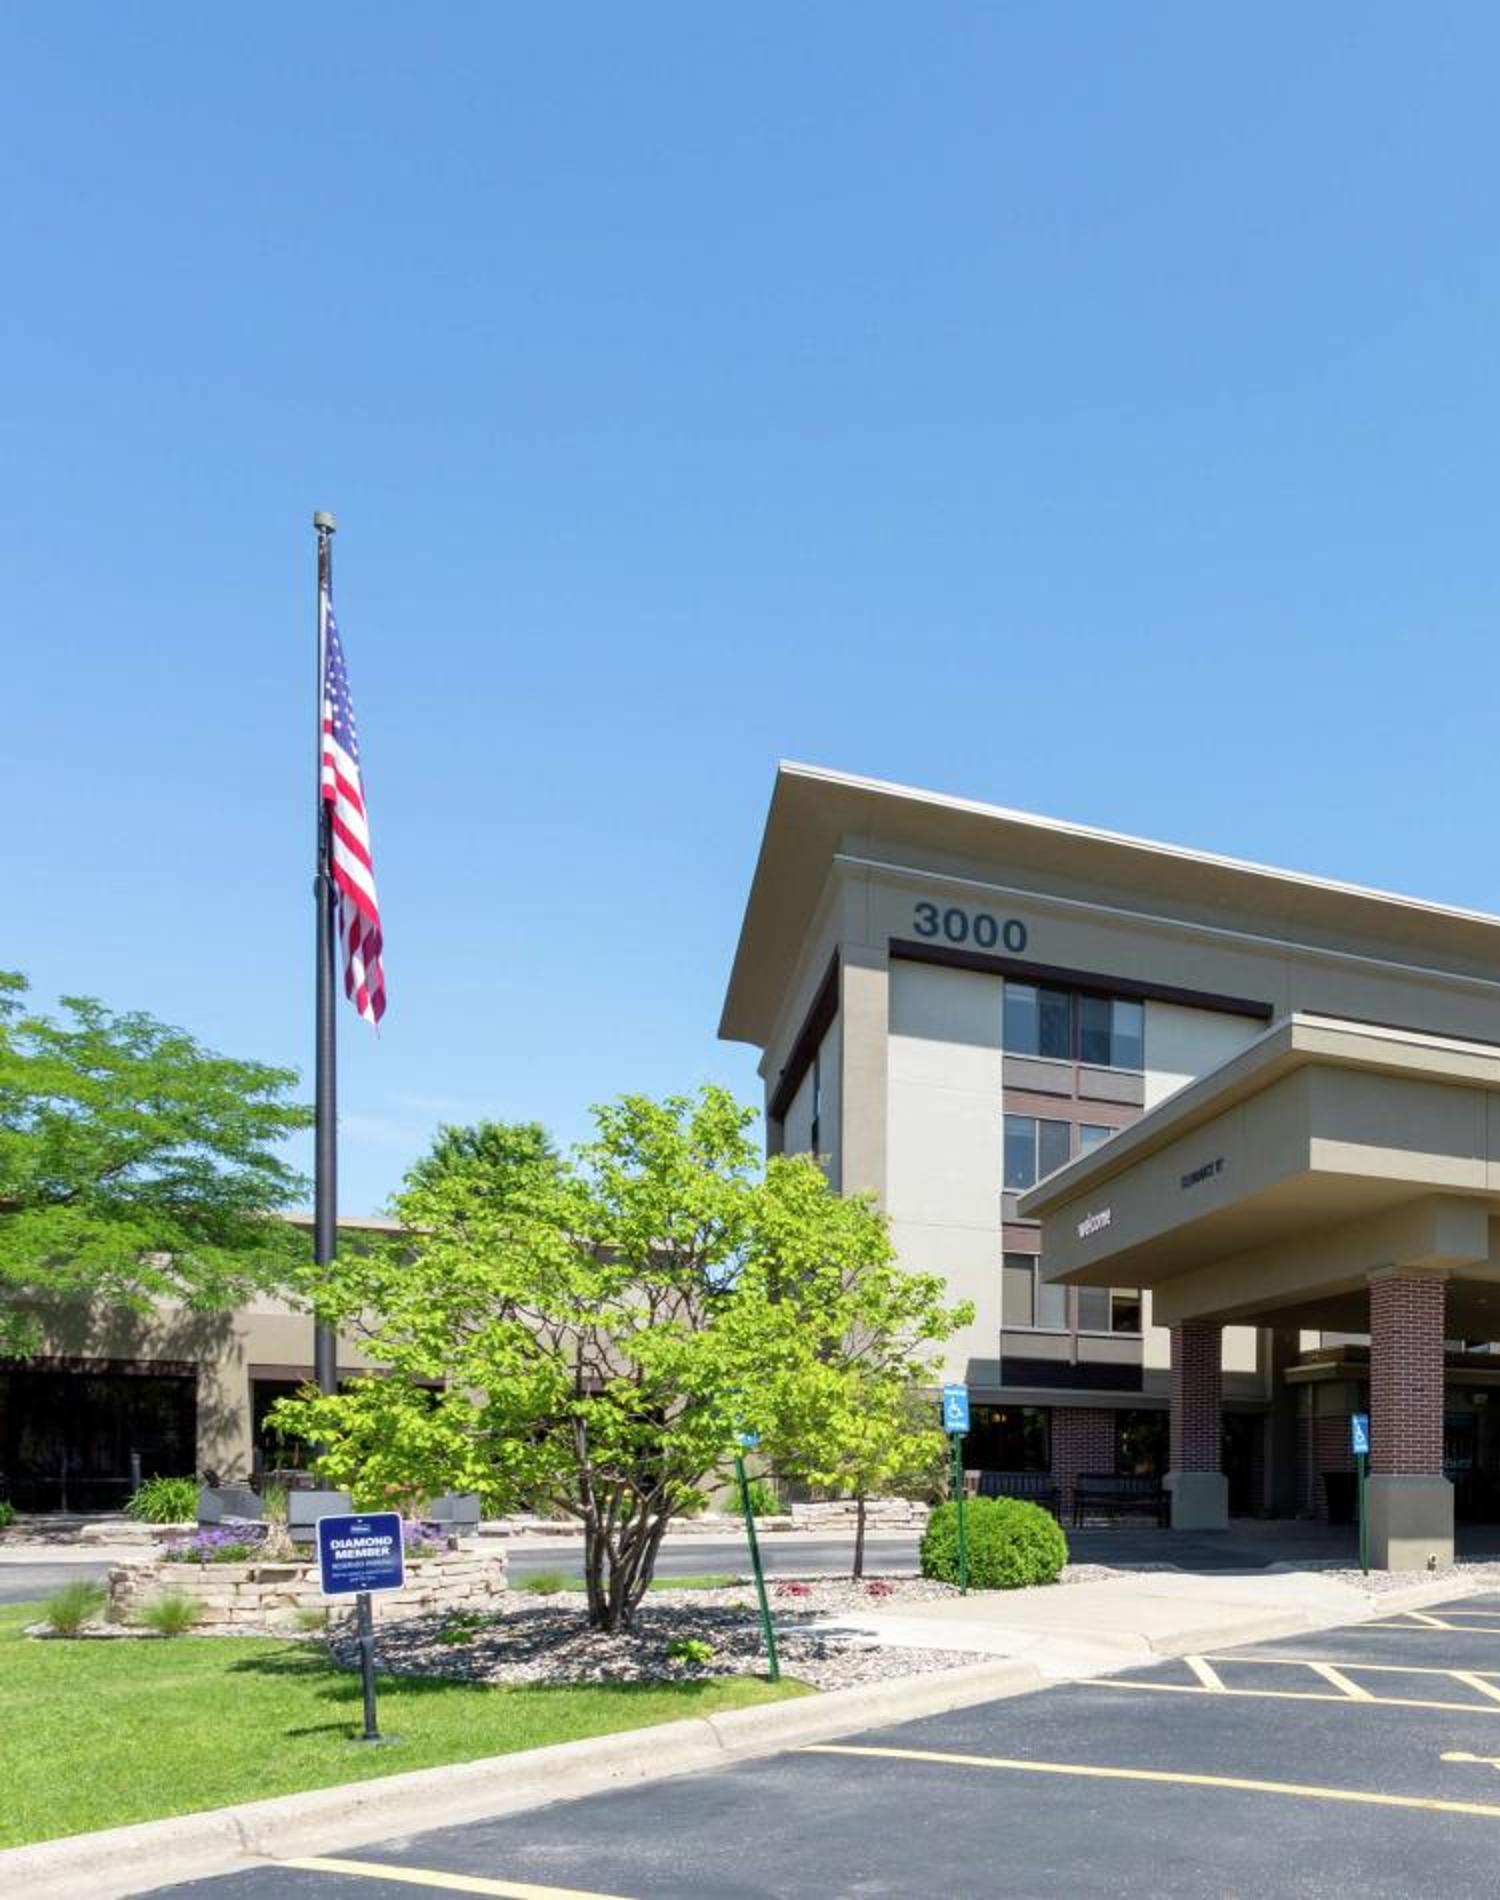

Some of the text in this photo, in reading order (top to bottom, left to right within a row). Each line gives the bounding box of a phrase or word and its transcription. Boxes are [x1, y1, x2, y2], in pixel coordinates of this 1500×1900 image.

[913, 902, 1027, 953] 3000
[330, 1536, 393, 1550] DIAMOND
[335, 1547, 390, 1560] MEMBER
